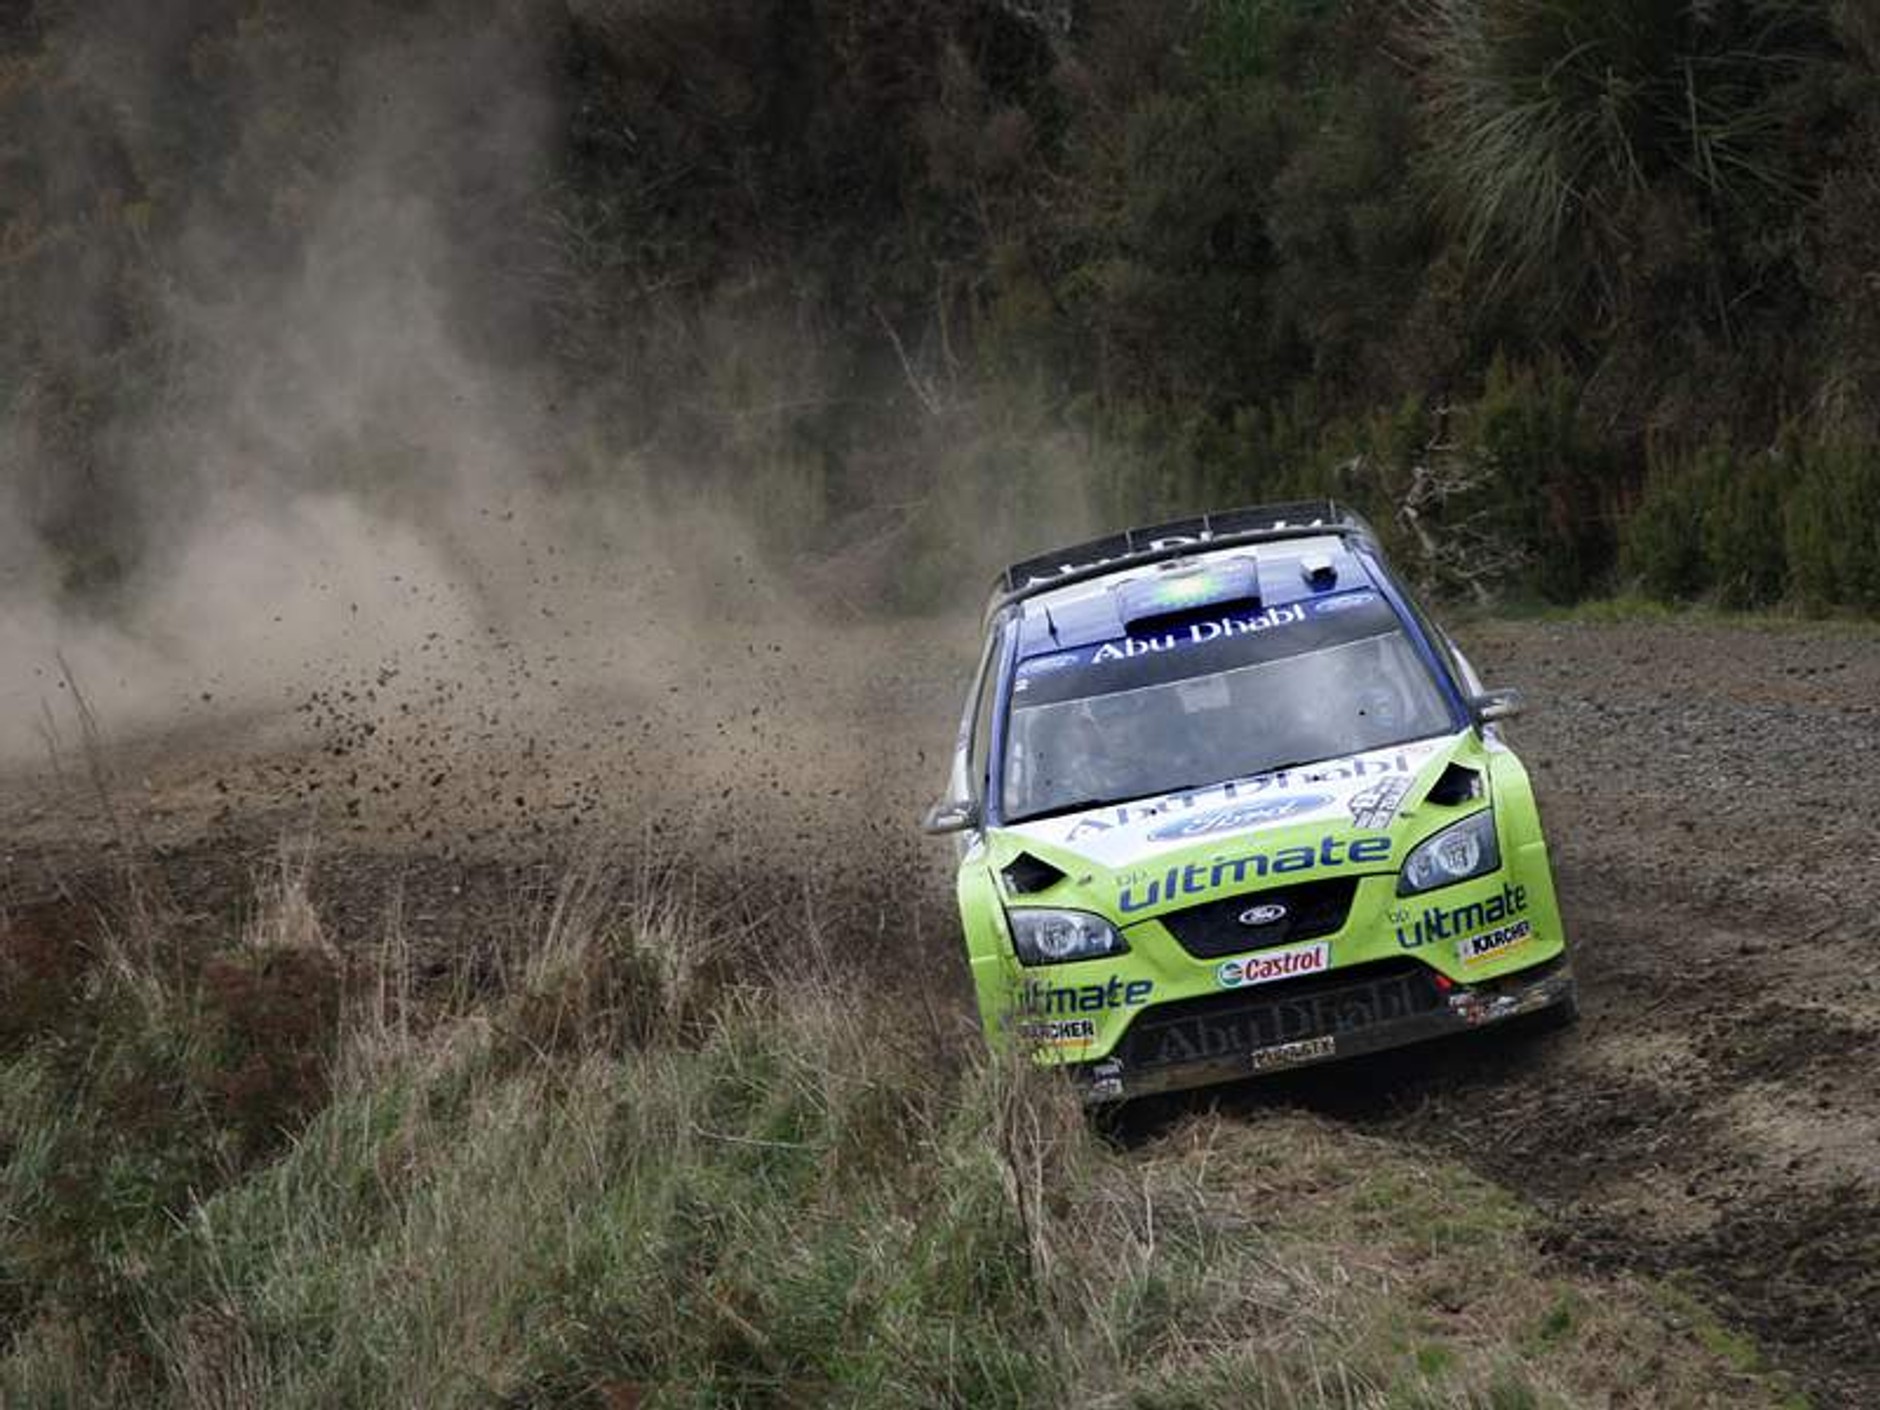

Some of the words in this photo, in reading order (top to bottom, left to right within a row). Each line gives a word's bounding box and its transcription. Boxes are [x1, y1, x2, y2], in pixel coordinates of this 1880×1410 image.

[1090, 632, 1174, 664] Abu
[1189, 603, 1306, 644] Dhabi
[1119, 835, 1392, 913] ultimate
[1396, 883, 1528, 949] ultimate
[1244, 946, 1322, 981] Castrol
[1161, 1015, 1261, 1062] Abu
